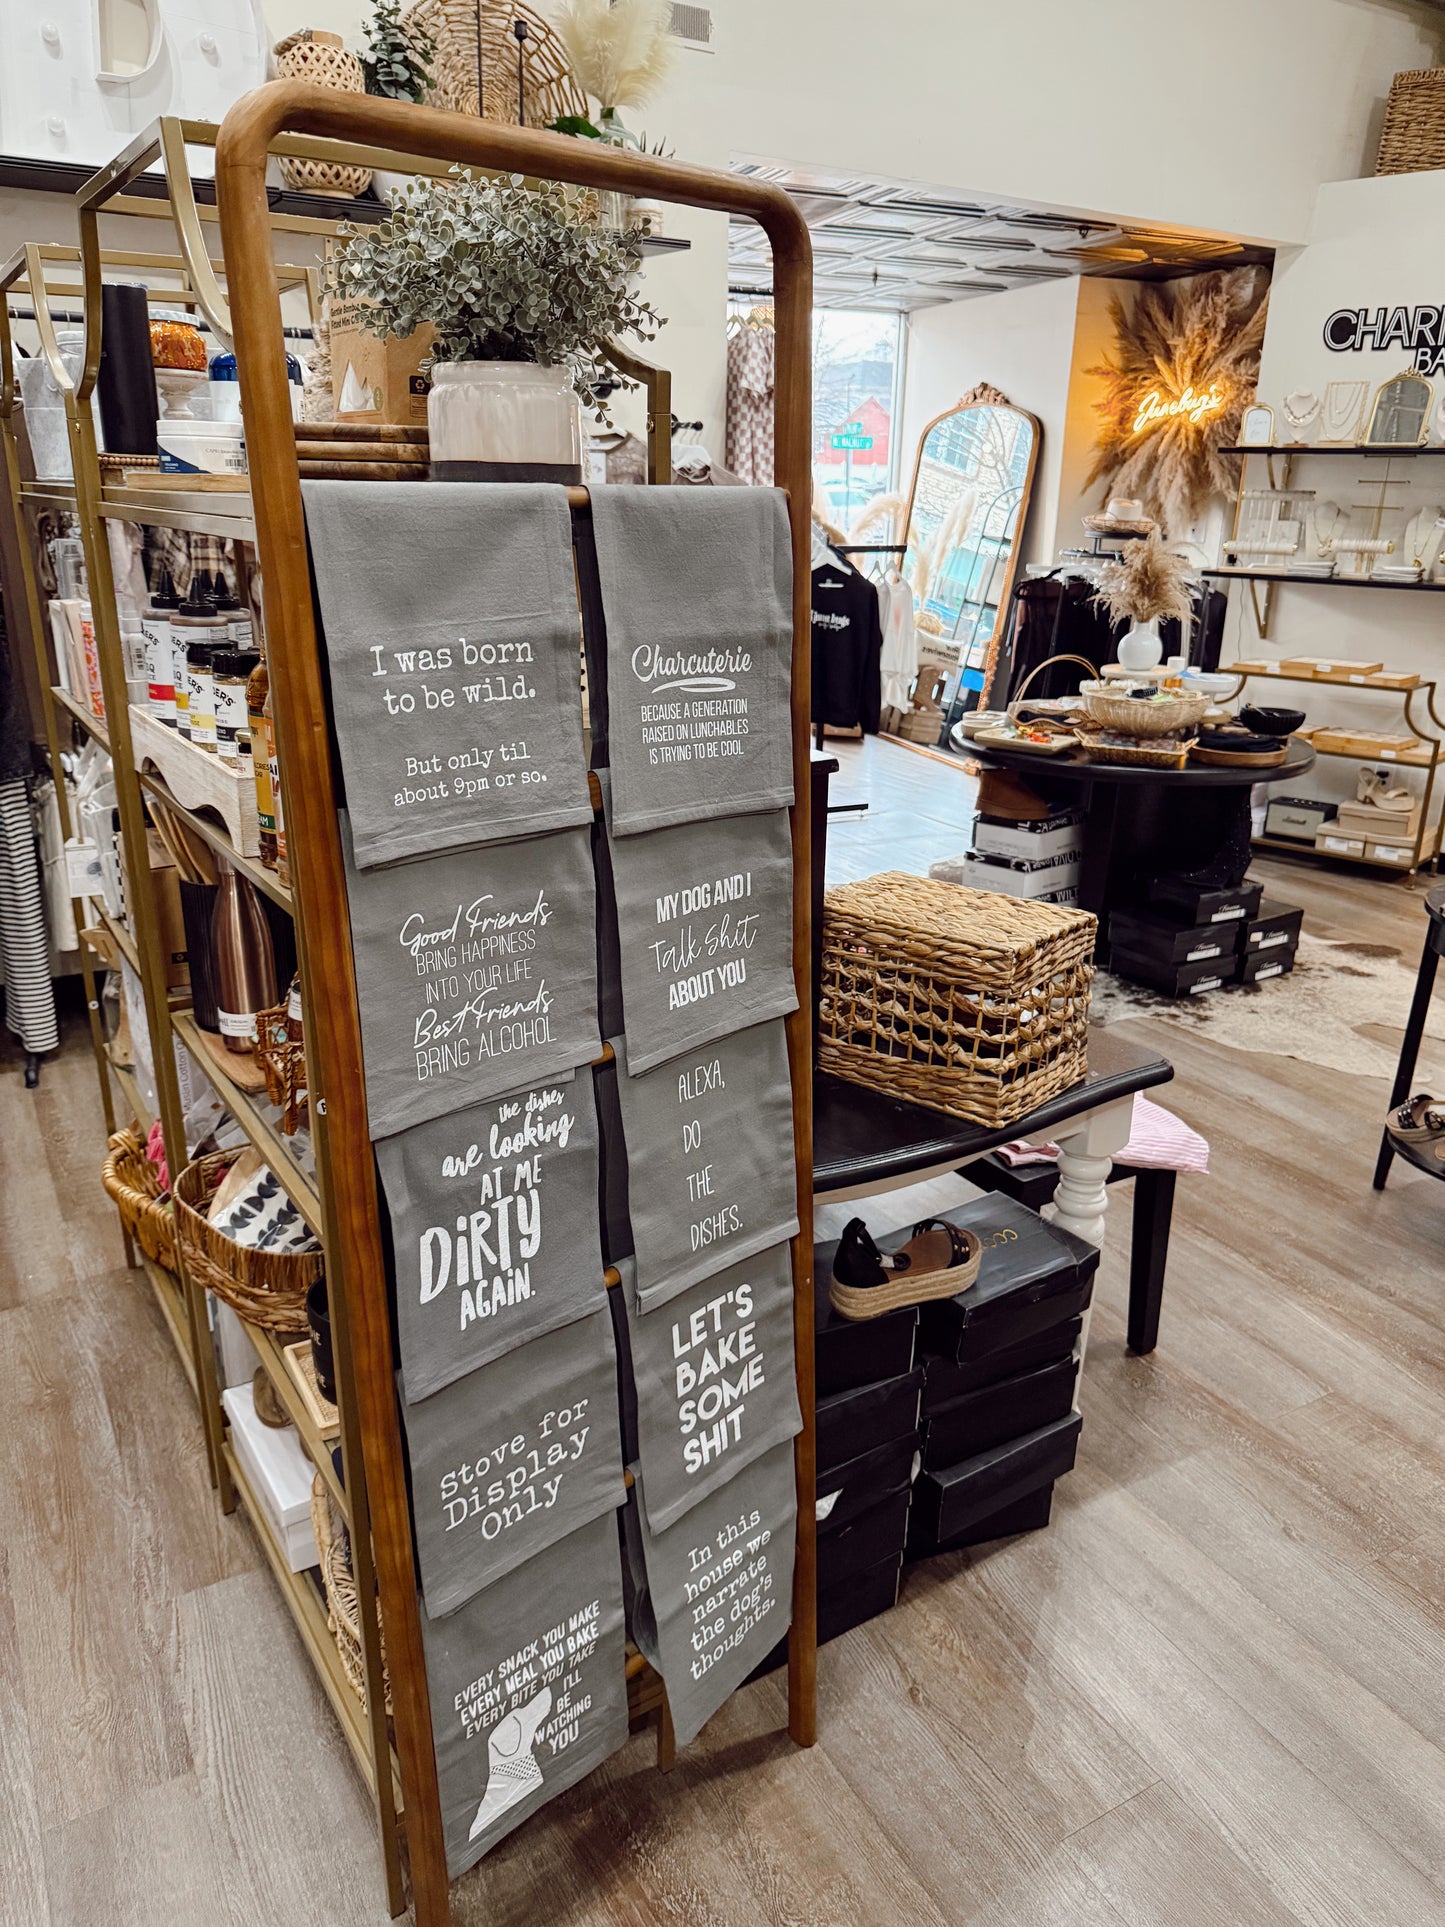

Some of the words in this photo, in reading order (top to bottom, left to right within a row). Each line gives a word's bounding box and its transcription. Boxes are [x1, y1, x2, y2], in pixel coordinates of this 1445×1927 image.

[1323, 304, 1445, 351] CHAR
[370, 645, 387, 676] I
[394, 647, 452, 673] was
[459, 638, 534, 665] born
[631, 644, 752, 682] Charcuterie
[383, 689, 415, 715] to
[421, 685, 455, 710] be
[462, 675, 536, 704] wild.
[641, 703, 682, 722] BECAUSE
[684, 702, 691, 718] A
[692, 698, 748, 717] GENERATION
[642, 725, 674, 744] RAISED
[676, 723, 689, 740] ON
[690, 719, 749, 739] LUNCHABLES
[649, 748, 658, 765] IS
[660, 745, 692, 763] TRYING
[693, 743, 705, 759] TO
[707, 742, 719, 758] BE
[721, 740, 744, 756] COOL
[405, 754, 442, 777] But
[448, 748, 494, 770] only
[499, 742, 531, 762] til
[394, 781, 449, 806] about
[454, 777, 490, 797] 9pm
[495, 771, 516, 787] or
[521, 770, 548, 784] so.
[400, 905, 462, 956] Good
[466, 890, 553, 937] Friends
[656, 893, 679, 923] MY
[682, 883, 711, 915] DOG
[714, 874, 744, 905] AND
[746, 872, 751, 897] I
[416, 946, 457, 975] BRING
[462, 929, 536, 964] HAPPINESS
[648, 925, 702, 973] Talk
[704, 913, 760, 956] Shit
[425, 976, 459, 1004] INTO
[463, 964, 502, 993] YOUR
[506, 958, 533, 983] LIFE
[669, 969, 715, 1011] ABOUT
[716, 958, 747, 990] YOU
[414, 1001, 471, 1048] Best
[471, 979, 554, 1028] Friends
[416, 1038, 470, 1081] BRING
[478, 1016, 557, 1061] ALCOHOL
[499, 1103, 522, 1123] the
[525, 1089, 565, 1112] dishes
[678, 1059, 726, 1103] ALEXA,
[442, 1144, 483, 1177] are
[489, 1112, 575, 1160] looking
[683, 1119, 702, 1154] DO
[480, 1166, 504, 1205] AT
[514, 1154, 542, 1192] ME
[686, 1165, 715, 1202] THE
[690, 1204, 744, 1252] DISHES.
[671, 1283, 754, 1359] LET'S
[676, 1321, 756, 1399] BAKE
[679, 1352, 765, 1435] SOME
[440, 1434, 526, 1501] Stove
[538, 1398, 589, 1439] for
[683, 1404, 745, 1475] SHIT
[443, 1426, 590, 1532] Display
[481, 1473, 564, 1540] Only
[684, 1550, 744, 1604] house
[747, 1529, 771, 1555] we
[688, 1544, 713, 1573] In
[716, 1510, 761, 1550] this
[690, 1616, 725, 1652] the
[730, 1573, 773, 1623] dog's
[692, 1555, 767, 1625] narrate
[454, 1669, 494, 1712] EVERY
[499, 1640, 539, 1679] SNACK
[542, 1622, 566, 1648] YOU
[569, 1600, 600, 1631] MAKE
[690, 1598, 776, 1681] thoughts.
[460, 1684, 501, 1726] EVERY
[505, 1659, 538, 1696] MEAL
[539, 1645, 564, 1669] YOU
[568, 1622, 600, 1651] BAKE
[466, 1701, 506, 1740] EVERY
[511, 1680, 537, 1709] BITE
[542, 1665, 564, 1687] YOU
[569, 1641, 596, 1669] TAKE
[535, 1695, 592, 1746] WATCHING
[556, 1692, 572, 1716] BE
[548, 1720, 580, 1755] YOU
